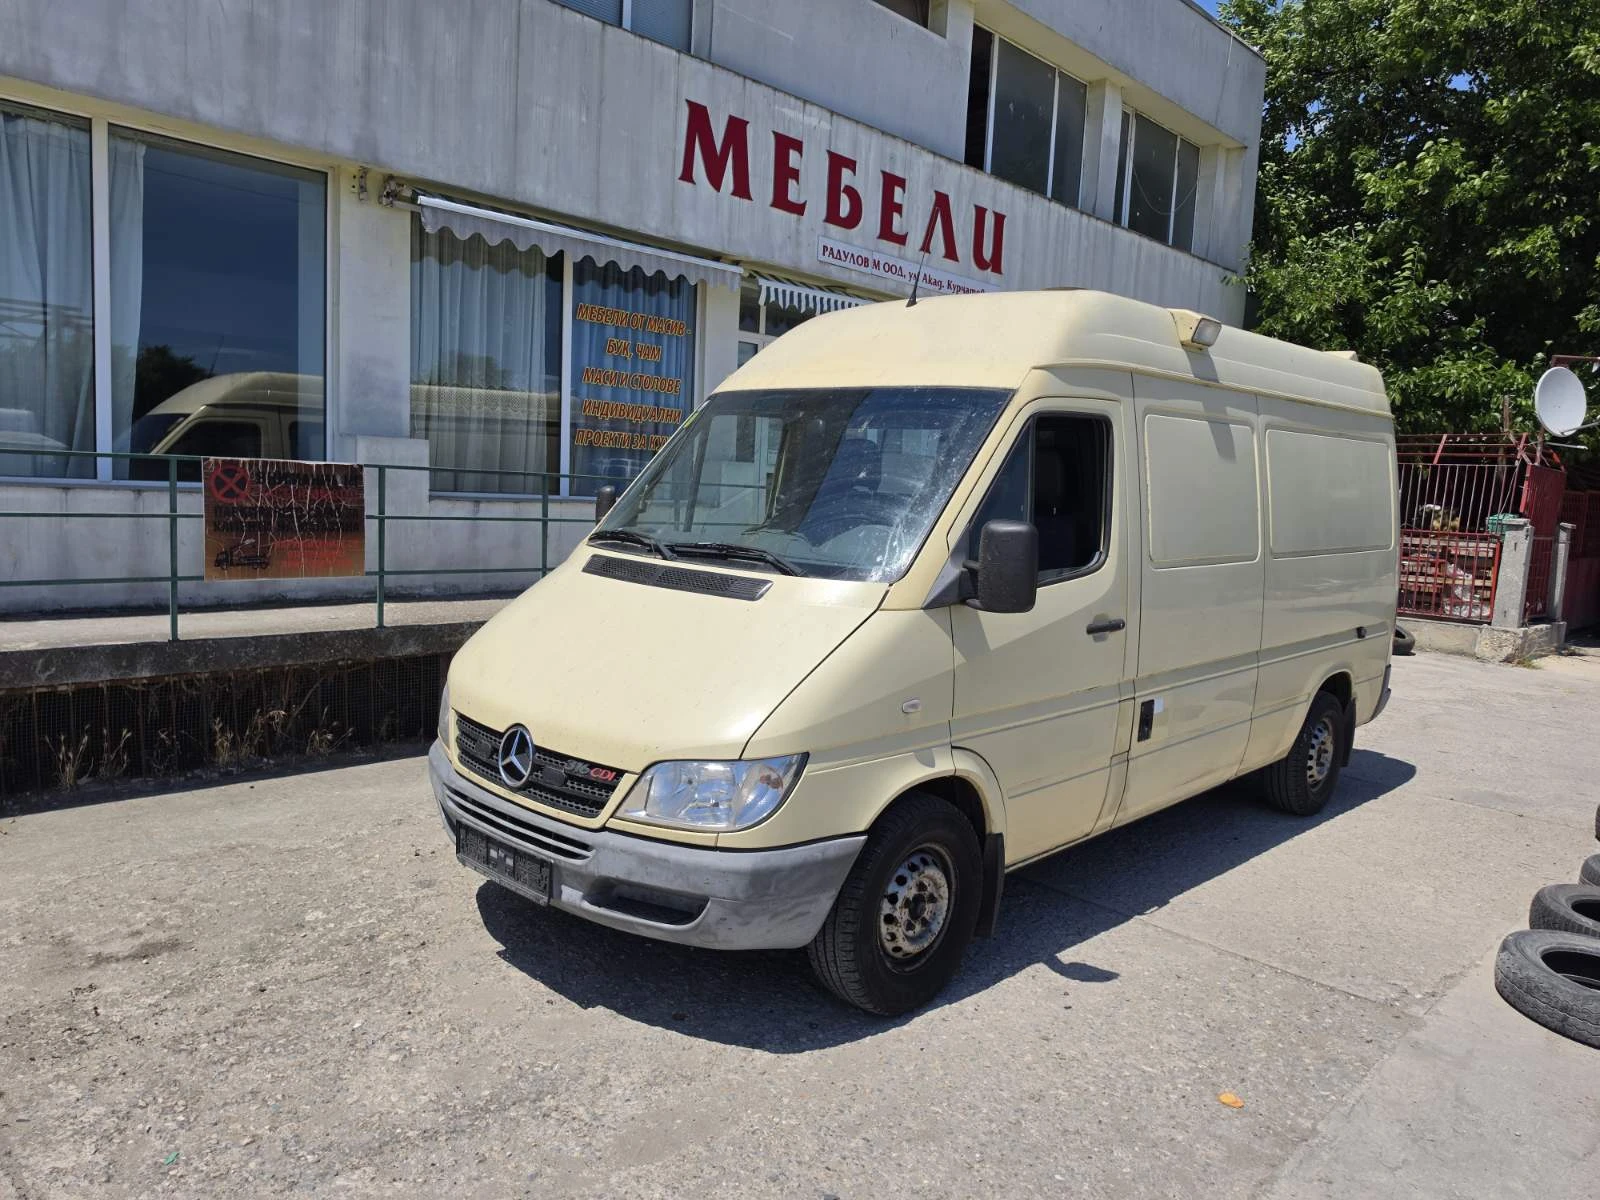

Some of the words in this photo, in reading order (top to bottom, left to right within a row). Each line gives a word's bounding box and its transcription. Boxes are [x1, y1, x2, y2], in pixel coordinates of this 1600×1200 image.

[678, 99, 1006, 275] МЕБЕЛИ
[822, 244, 870, 268] РАДУЛОВ
[576, 303, 629, 328] МЕБЕЛИ
[630, 313, 646, 330] ОТ
[646, 316, 686, 336] МАСИВ
[606, 337, 633, 360] БУК,
[635, 343, 662, 362] ЧАМ
[582, 367, 619, 387] МАСИ
[620, 374, 629, 389] И
[630, 374, 681, 396] СТОЛОВЕ
[582, 399, 682, 424] ИНДИВИДУАЛНИ
[575, 429, 632, 449] ПРОЕКТИ
[632, 434, 647, 450] ЗА
[591, 768, 616, 781] CDI
